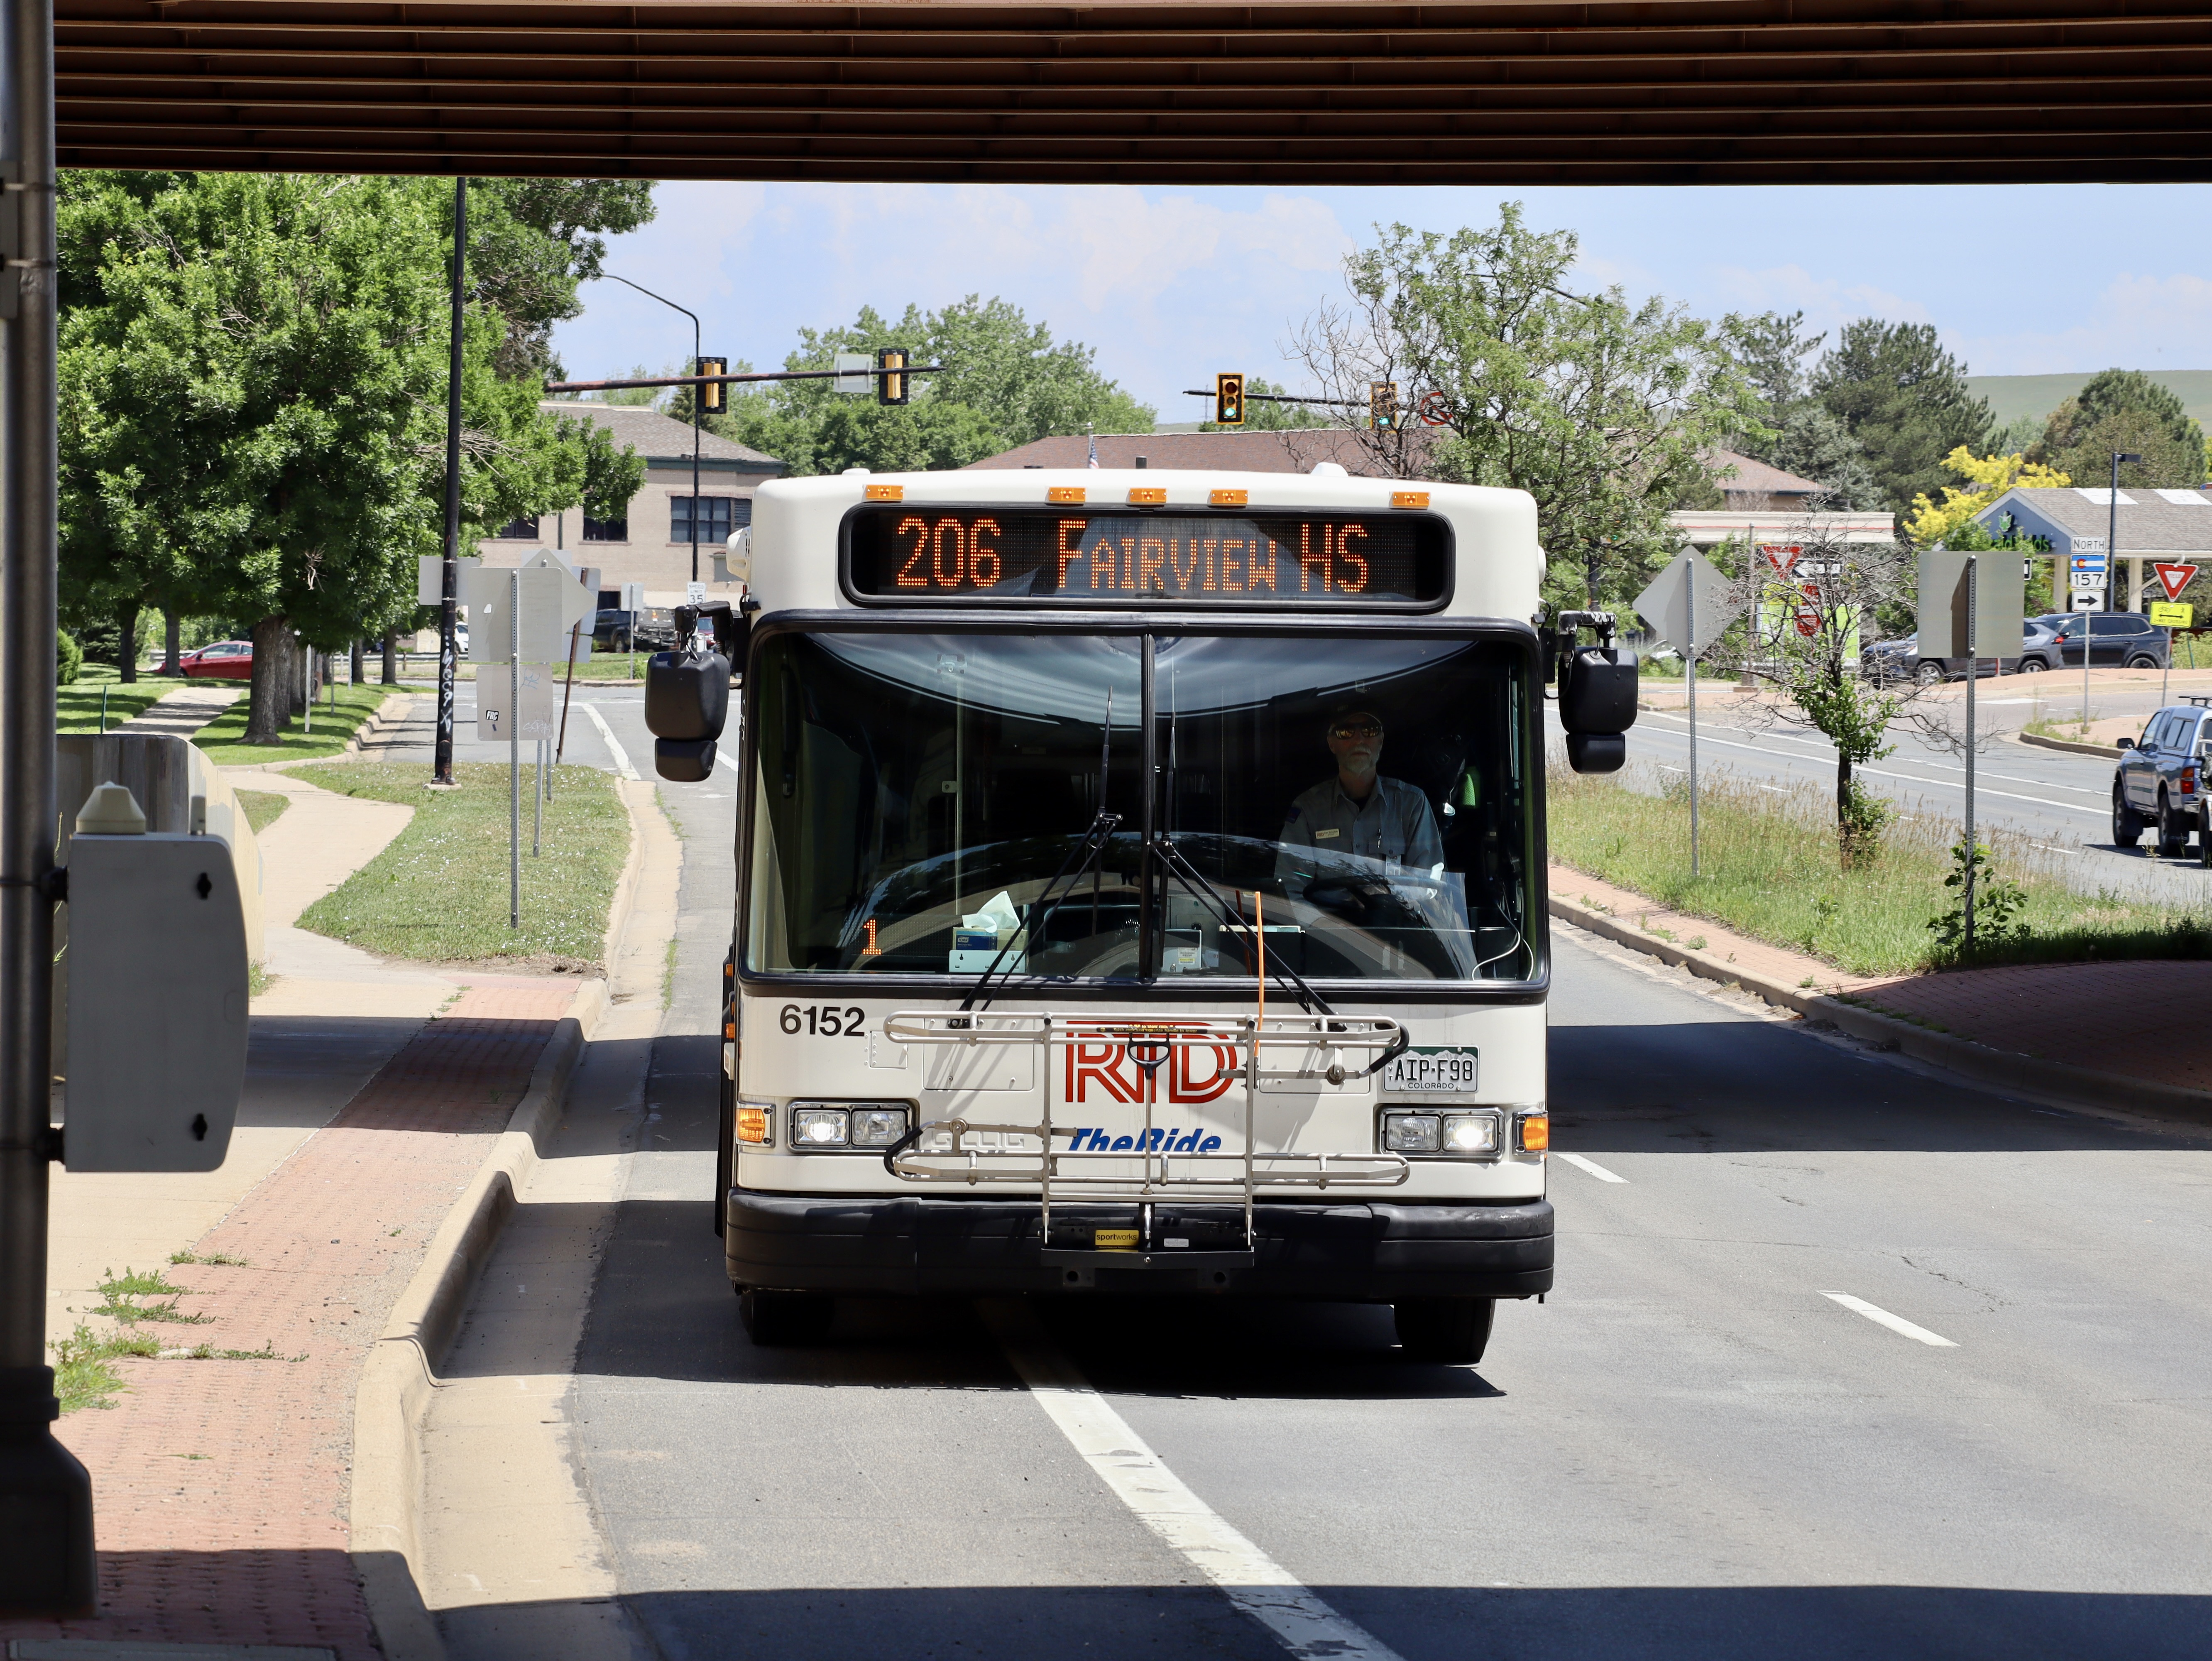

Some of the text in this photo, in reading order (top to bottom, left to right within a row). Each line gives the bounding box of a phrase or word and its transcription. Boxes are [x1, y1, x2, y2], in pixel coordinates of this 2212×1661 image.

[898, 517, 1368, 592] 206 FAIRVIEW HS
[2074, 539, 2104, 549] NORTH
[2075, 574, 2102, 586] 157
[690, 594, 703, 604] 35
[486, 710, 498, 720] FRC
[863, 919, 881, 955] 1
[780, 1004, 865, 1036] 6152
[1065, 1020, 1237, 1104] RTD
[1068, 1128, 1222, 1152] TheRide
